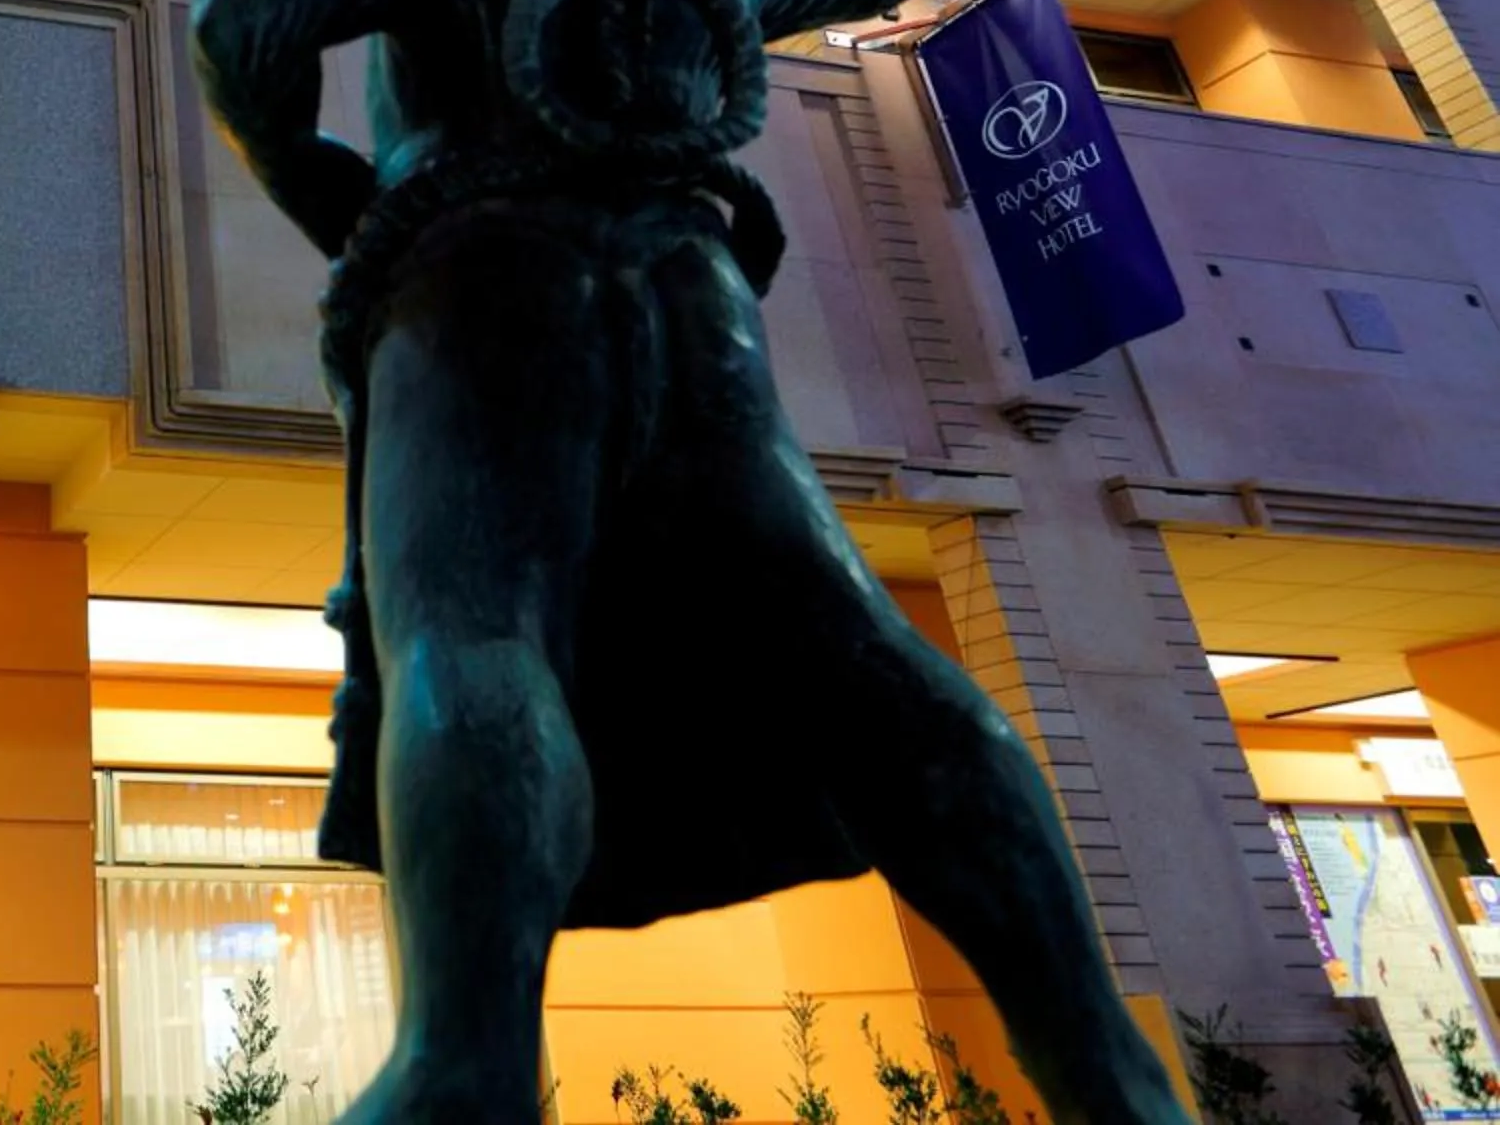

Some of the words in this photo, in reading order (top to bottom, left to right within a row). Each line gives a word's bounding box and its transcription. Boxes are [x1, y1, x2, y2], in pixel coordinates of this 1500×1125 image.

[995, 141, 1101, 215] RYOGOKU
[1029, 183, 1082, 226] VIEW
[1037, 212, 1103, 262] HOTEL
